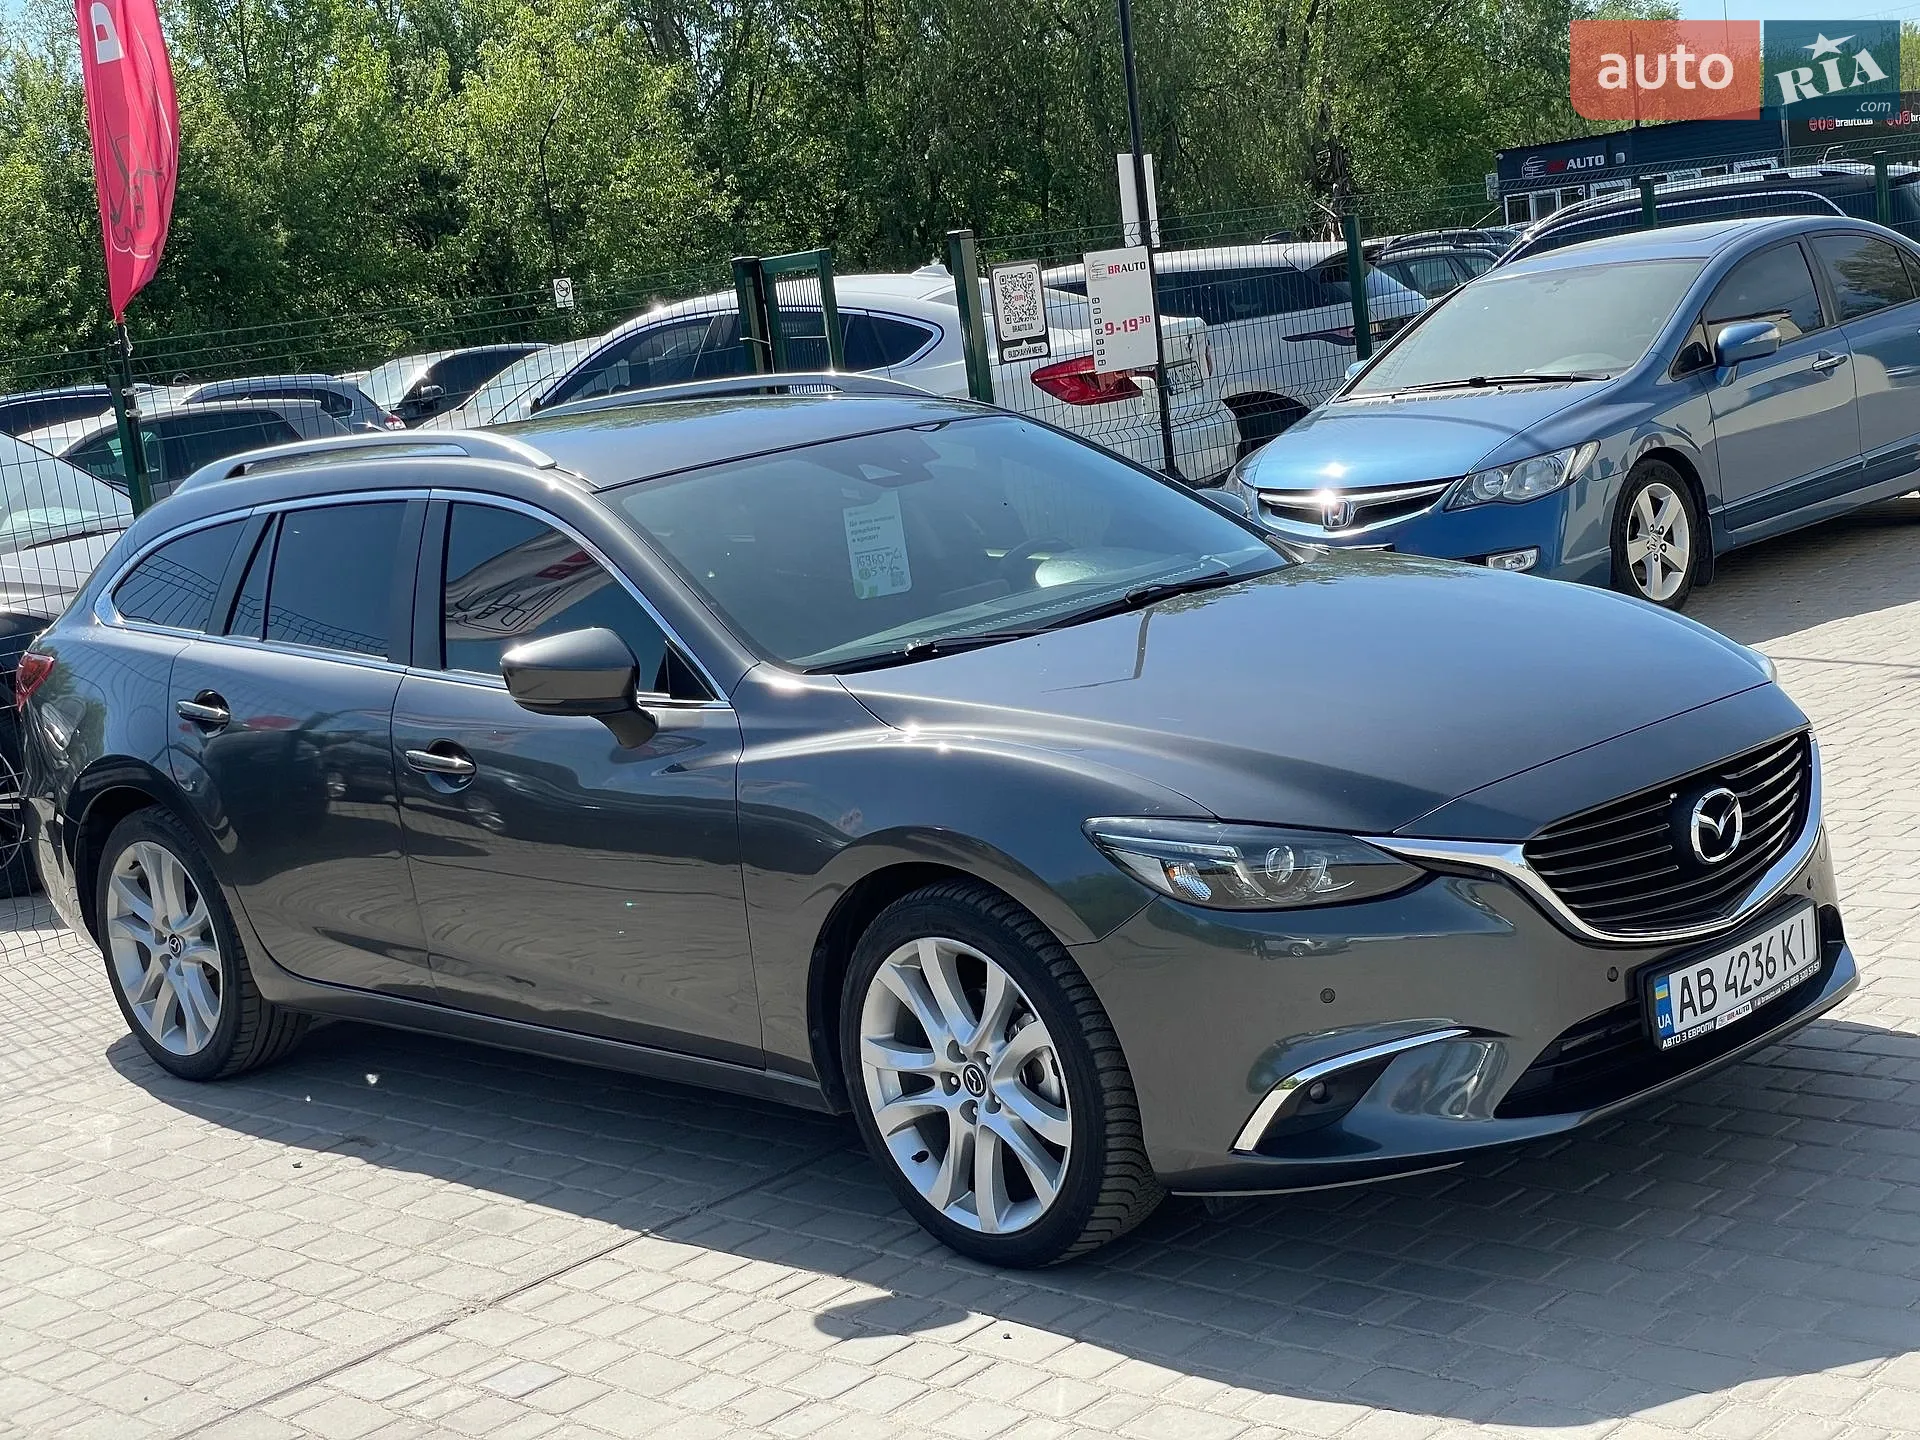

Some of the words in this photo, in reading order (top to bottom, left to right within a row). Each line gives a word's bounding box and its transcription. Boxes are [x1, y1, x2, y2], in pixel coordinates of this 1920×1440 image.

[1107, 261, 1147, 275] BRAUTO
[1679, 967, 1718, 1024] AB
[1724, 935, 1777, 999] 4236
[1781, 918, 1806, 971] KI
[1657, 1014, 1672, 1029] UA
[1662, 1034, 1681, 1049] АВТО
